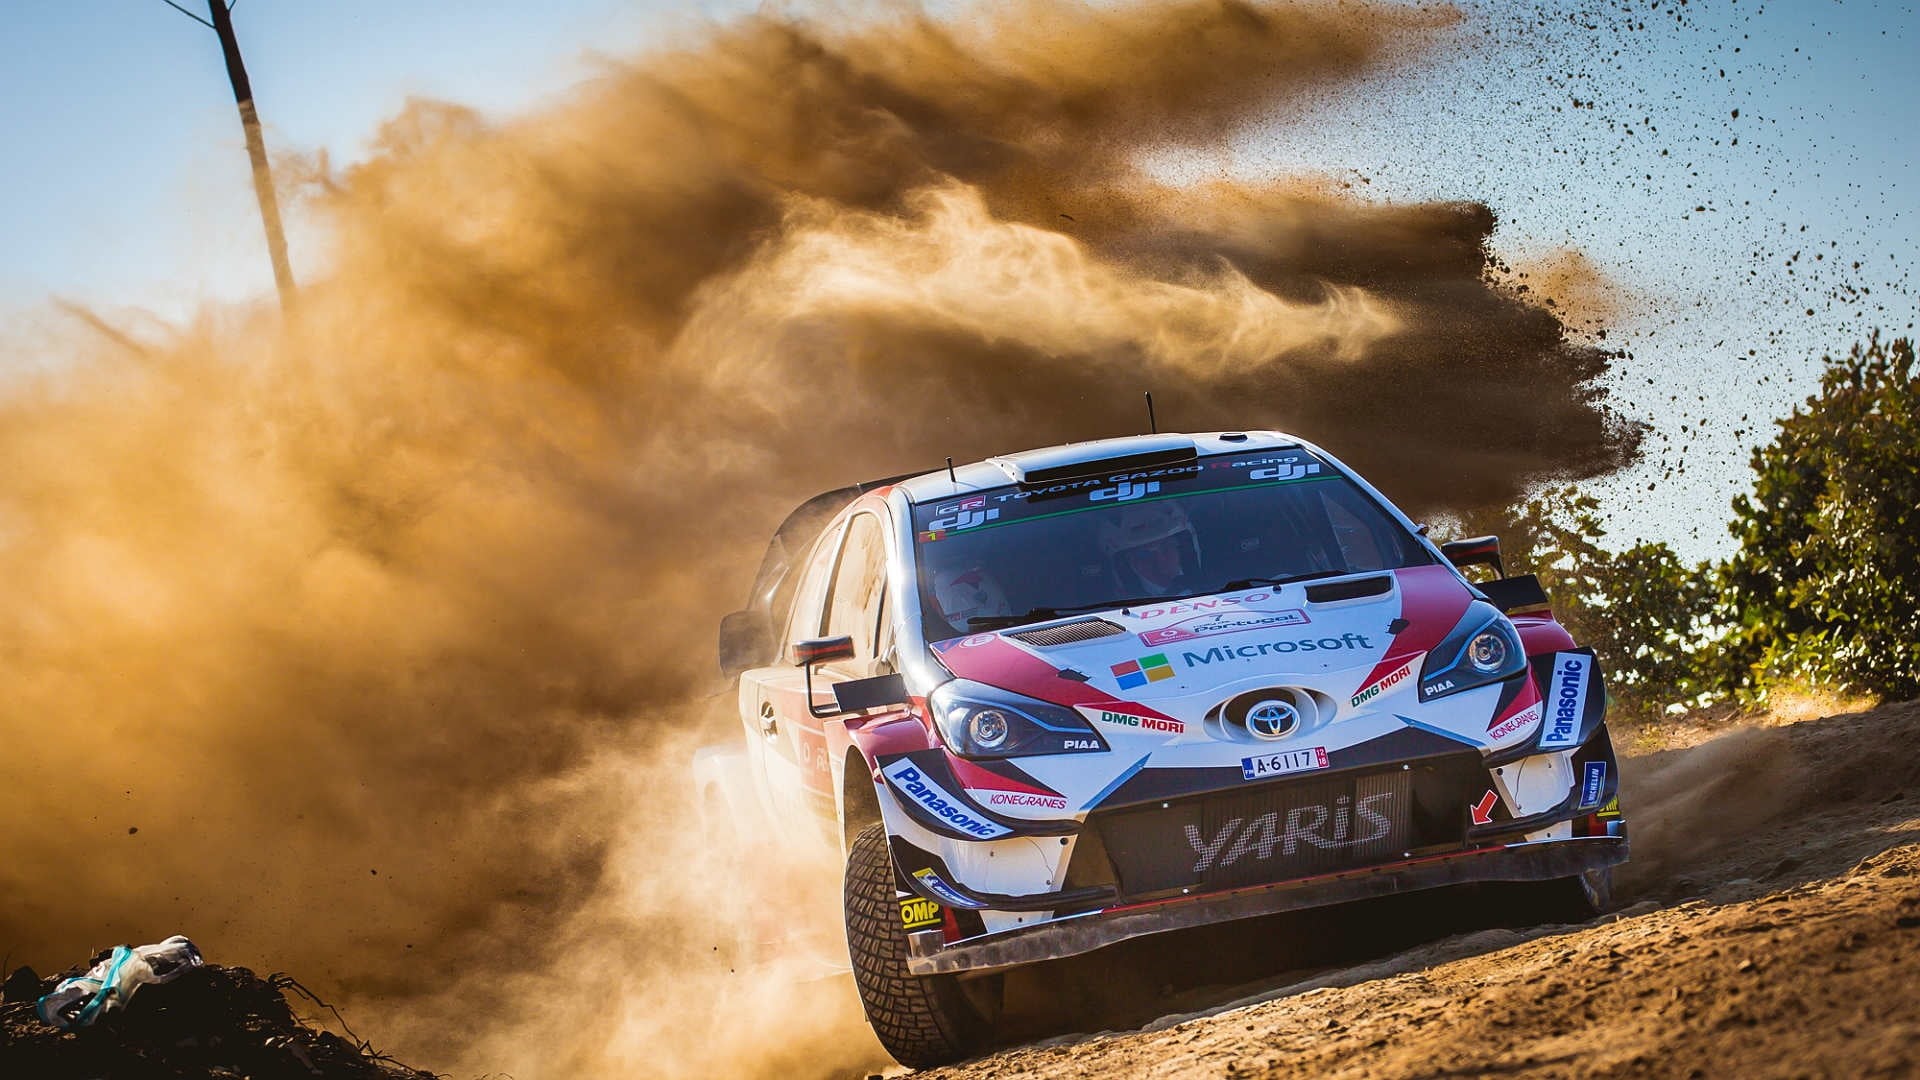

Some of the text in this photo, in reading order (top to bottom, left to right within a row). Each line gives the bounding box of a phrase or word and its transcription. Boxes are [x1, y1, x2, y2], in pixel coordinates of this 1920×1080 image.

[993, 456, 1298, 502] TOYOTA GAZOO Racing
[1140, 593, 1271, 620] DENSO
[1194, 614, 1299, 633] Portugal
[1182, 632, 1374, 668] Microsoft
[1351, 665, 1412, 708] DMG MORI
[1424, 679, 1455, 696] PIAA
[1546, 659, 1582, 743] Panasonic
[1101, 711, 1185, 734] DMG MORI
[1490, 711, 1539, 740] KONECRANES
[1063, 740, 1100, 749] PIAA
[1316, 748, 1325, 756] 12
[1318, 757, 1328, 765] 18
[893, 766, 996, 837] Panasonic
[990, 794, 1067, 810] KONECRANES
[901, 901, 939, 924] OMP
